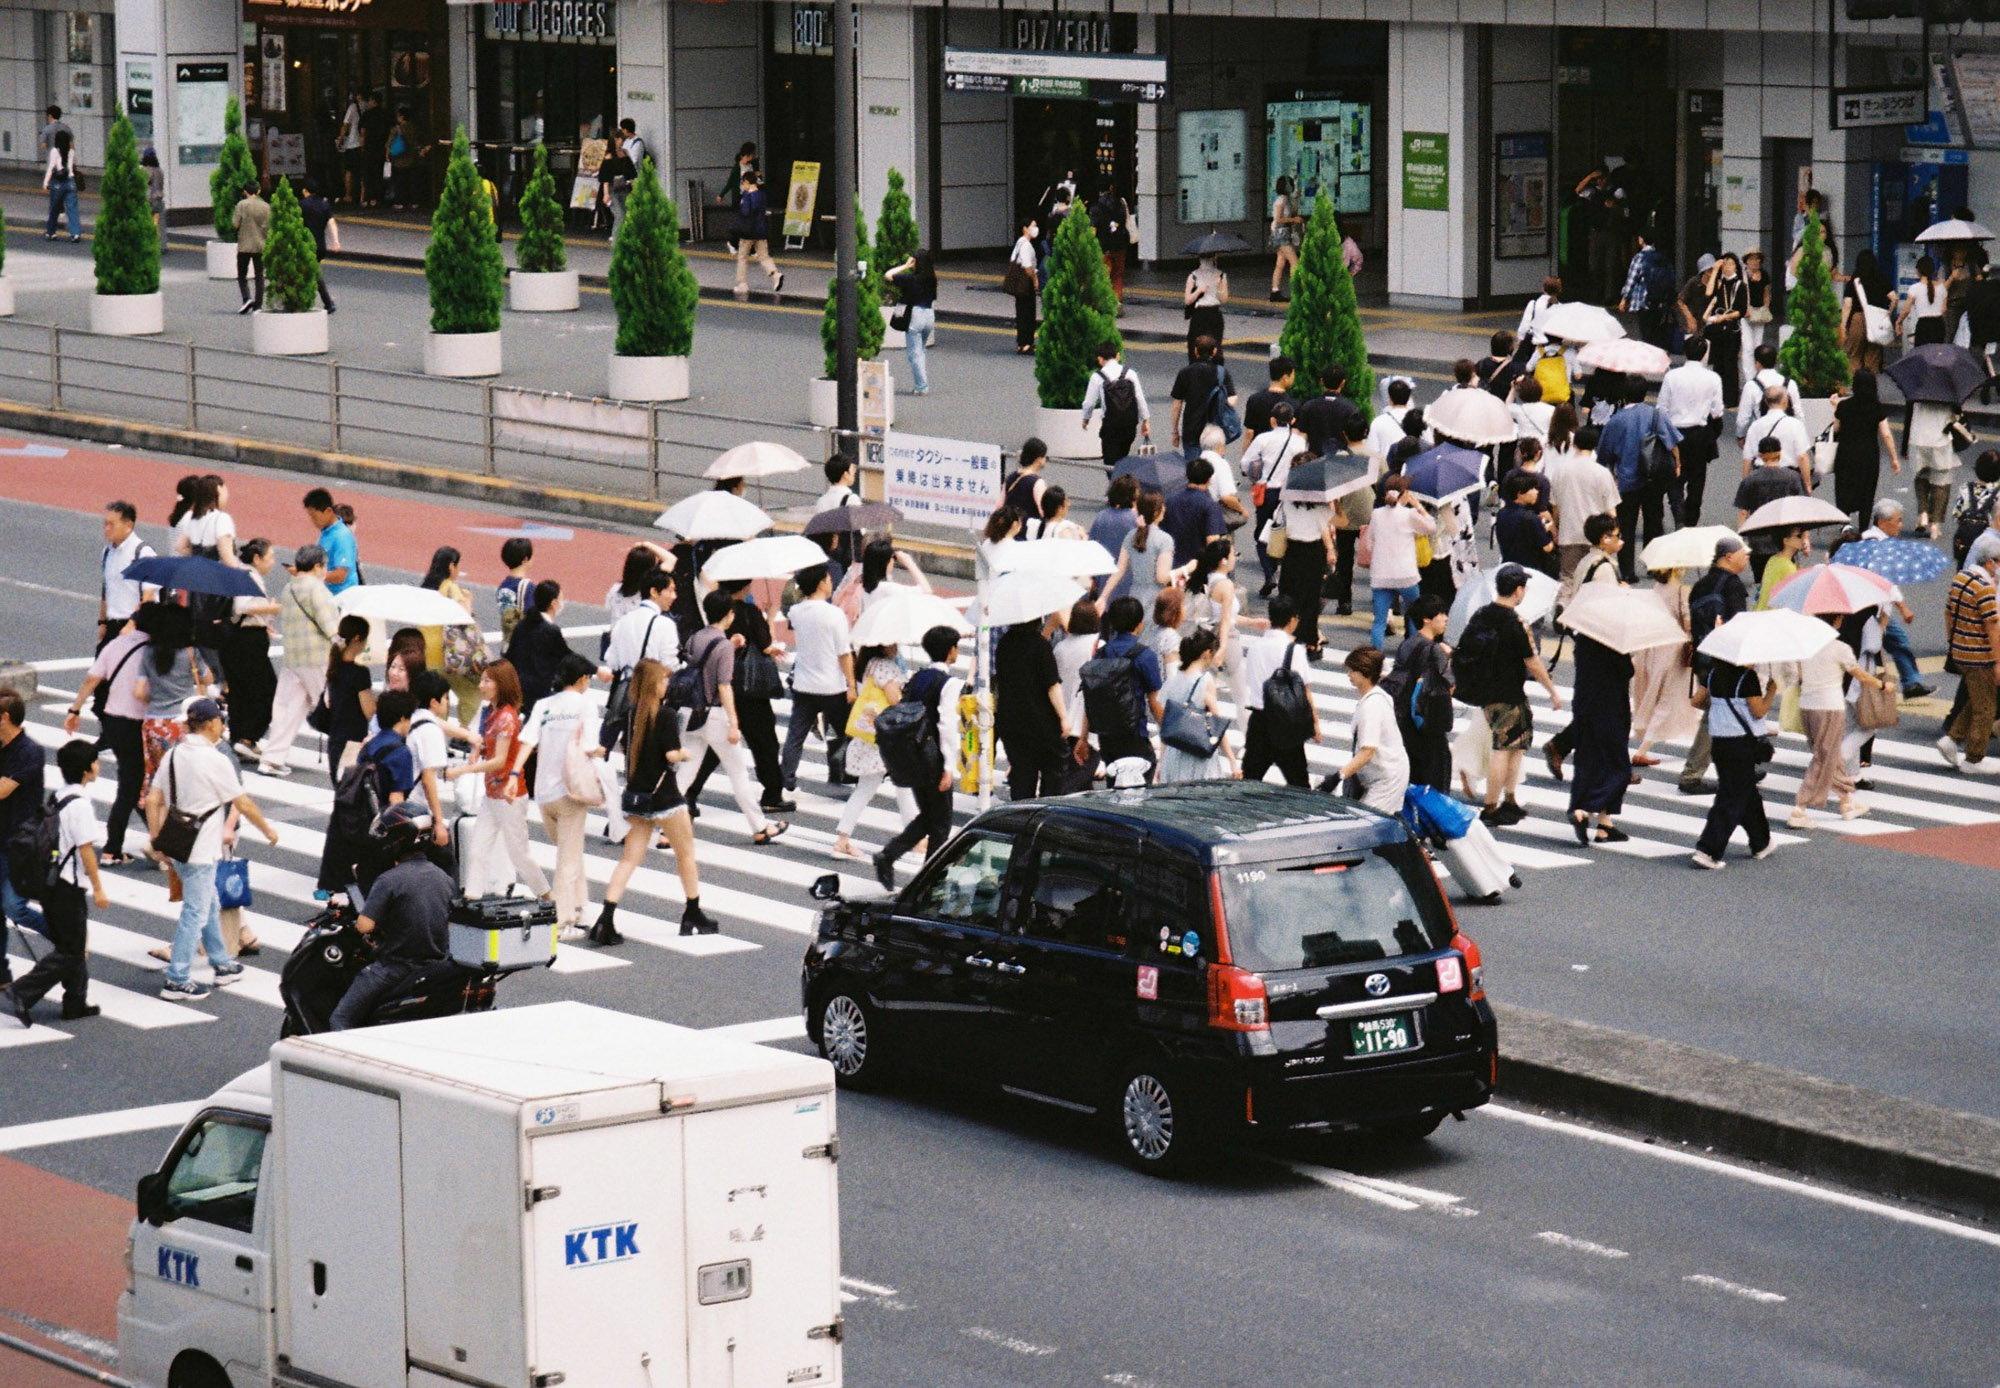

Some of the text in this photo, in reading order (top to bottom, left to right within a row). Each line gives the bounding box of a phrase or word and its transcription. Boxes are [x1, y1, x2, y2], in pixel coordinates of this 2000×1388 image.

[529, 1, 605, 36] DEGREES
[1237, 871, 1265, 884] 1190
[1366, 1028, 1407, 1052] 11-90
[565, 1223, 641, 1266] KTK
[158, 1246, 199, 1286] KTK
